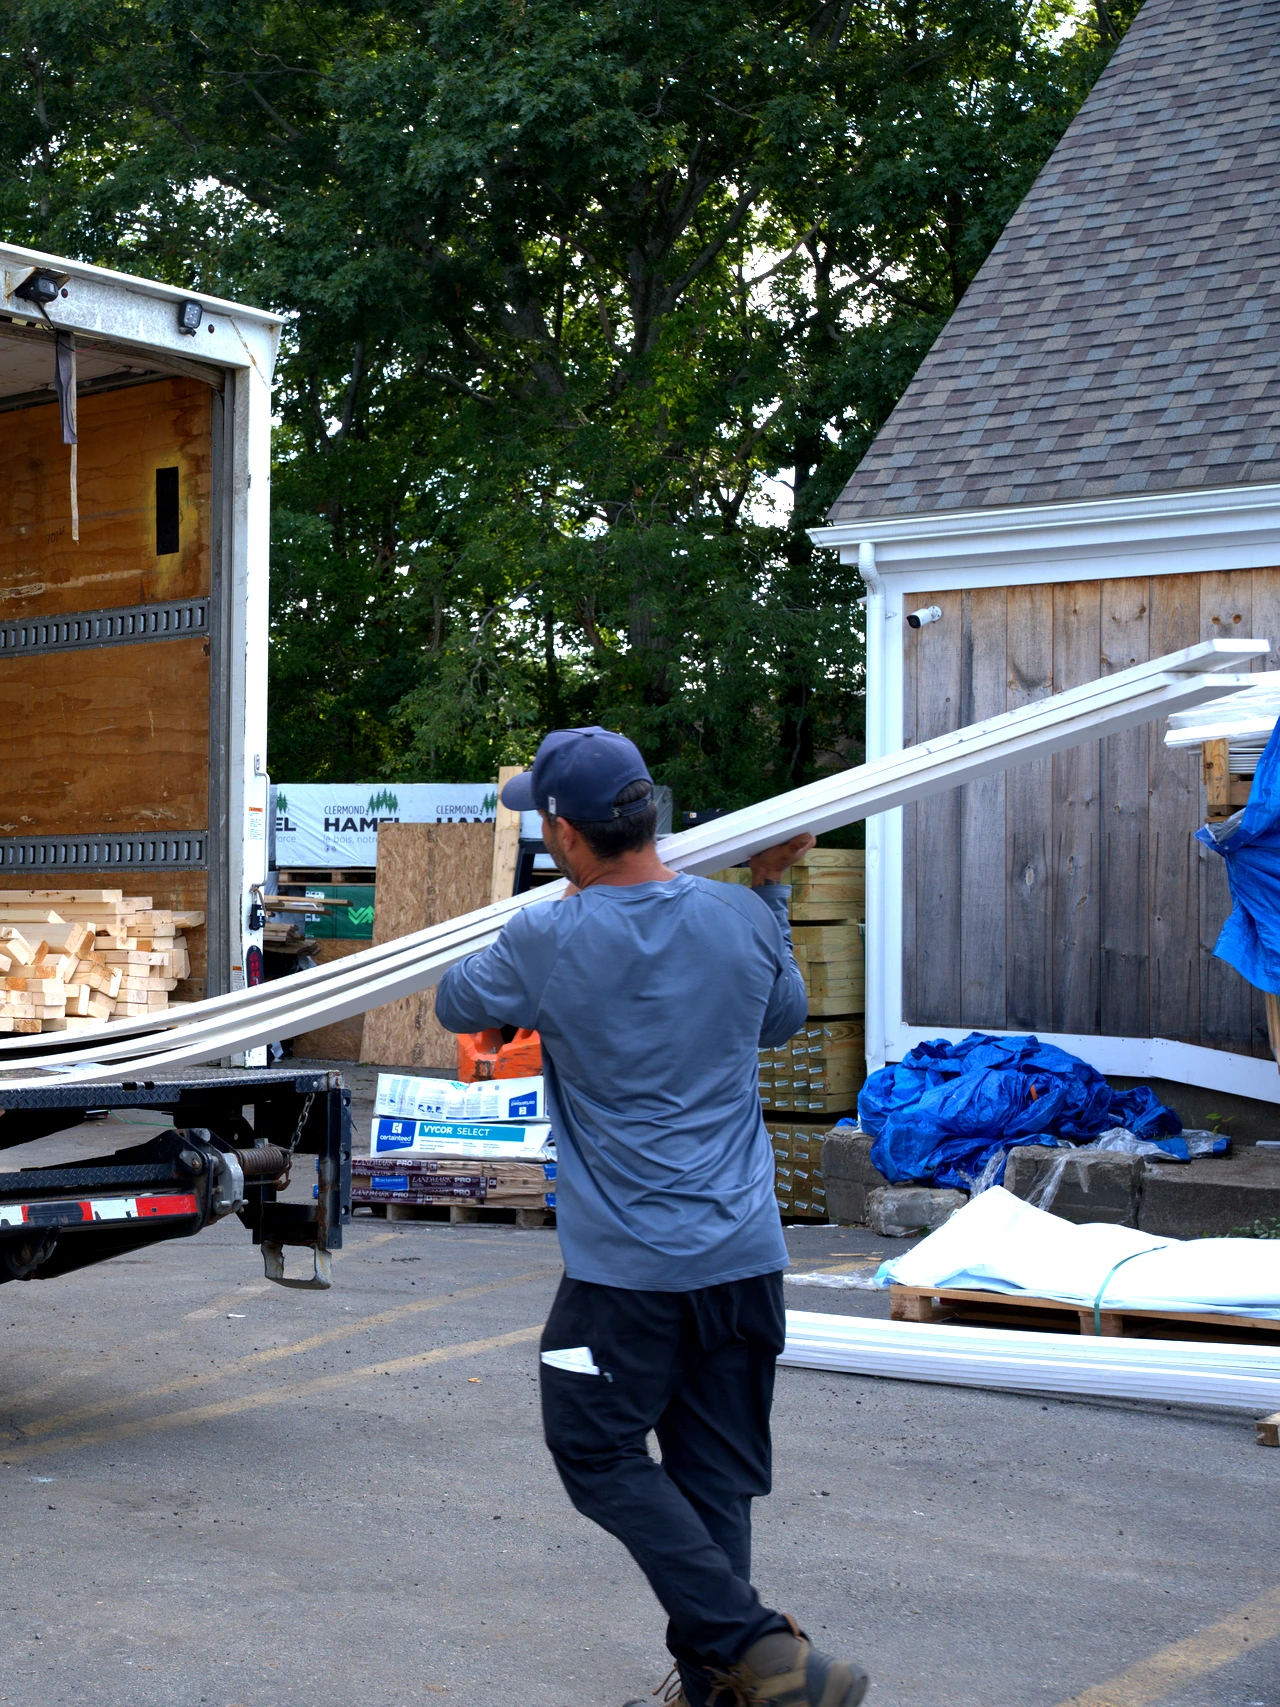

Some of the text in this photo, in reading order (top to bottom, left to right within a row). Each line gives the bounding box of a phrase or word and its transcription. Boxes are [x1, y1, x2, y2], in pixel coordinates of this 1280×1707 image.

[324, 805, 365, 815] CLERMOND
[435, 805, 479, 815] CLERMOND
[324, 817, 400, 833] HAM
[275, 836, 297, 844] orce
[357, 836, 377, 844] notr
[423, 1125, 489, 1137] VYCOR SELECT
[379, 1134, 412, 1142] certainteed
